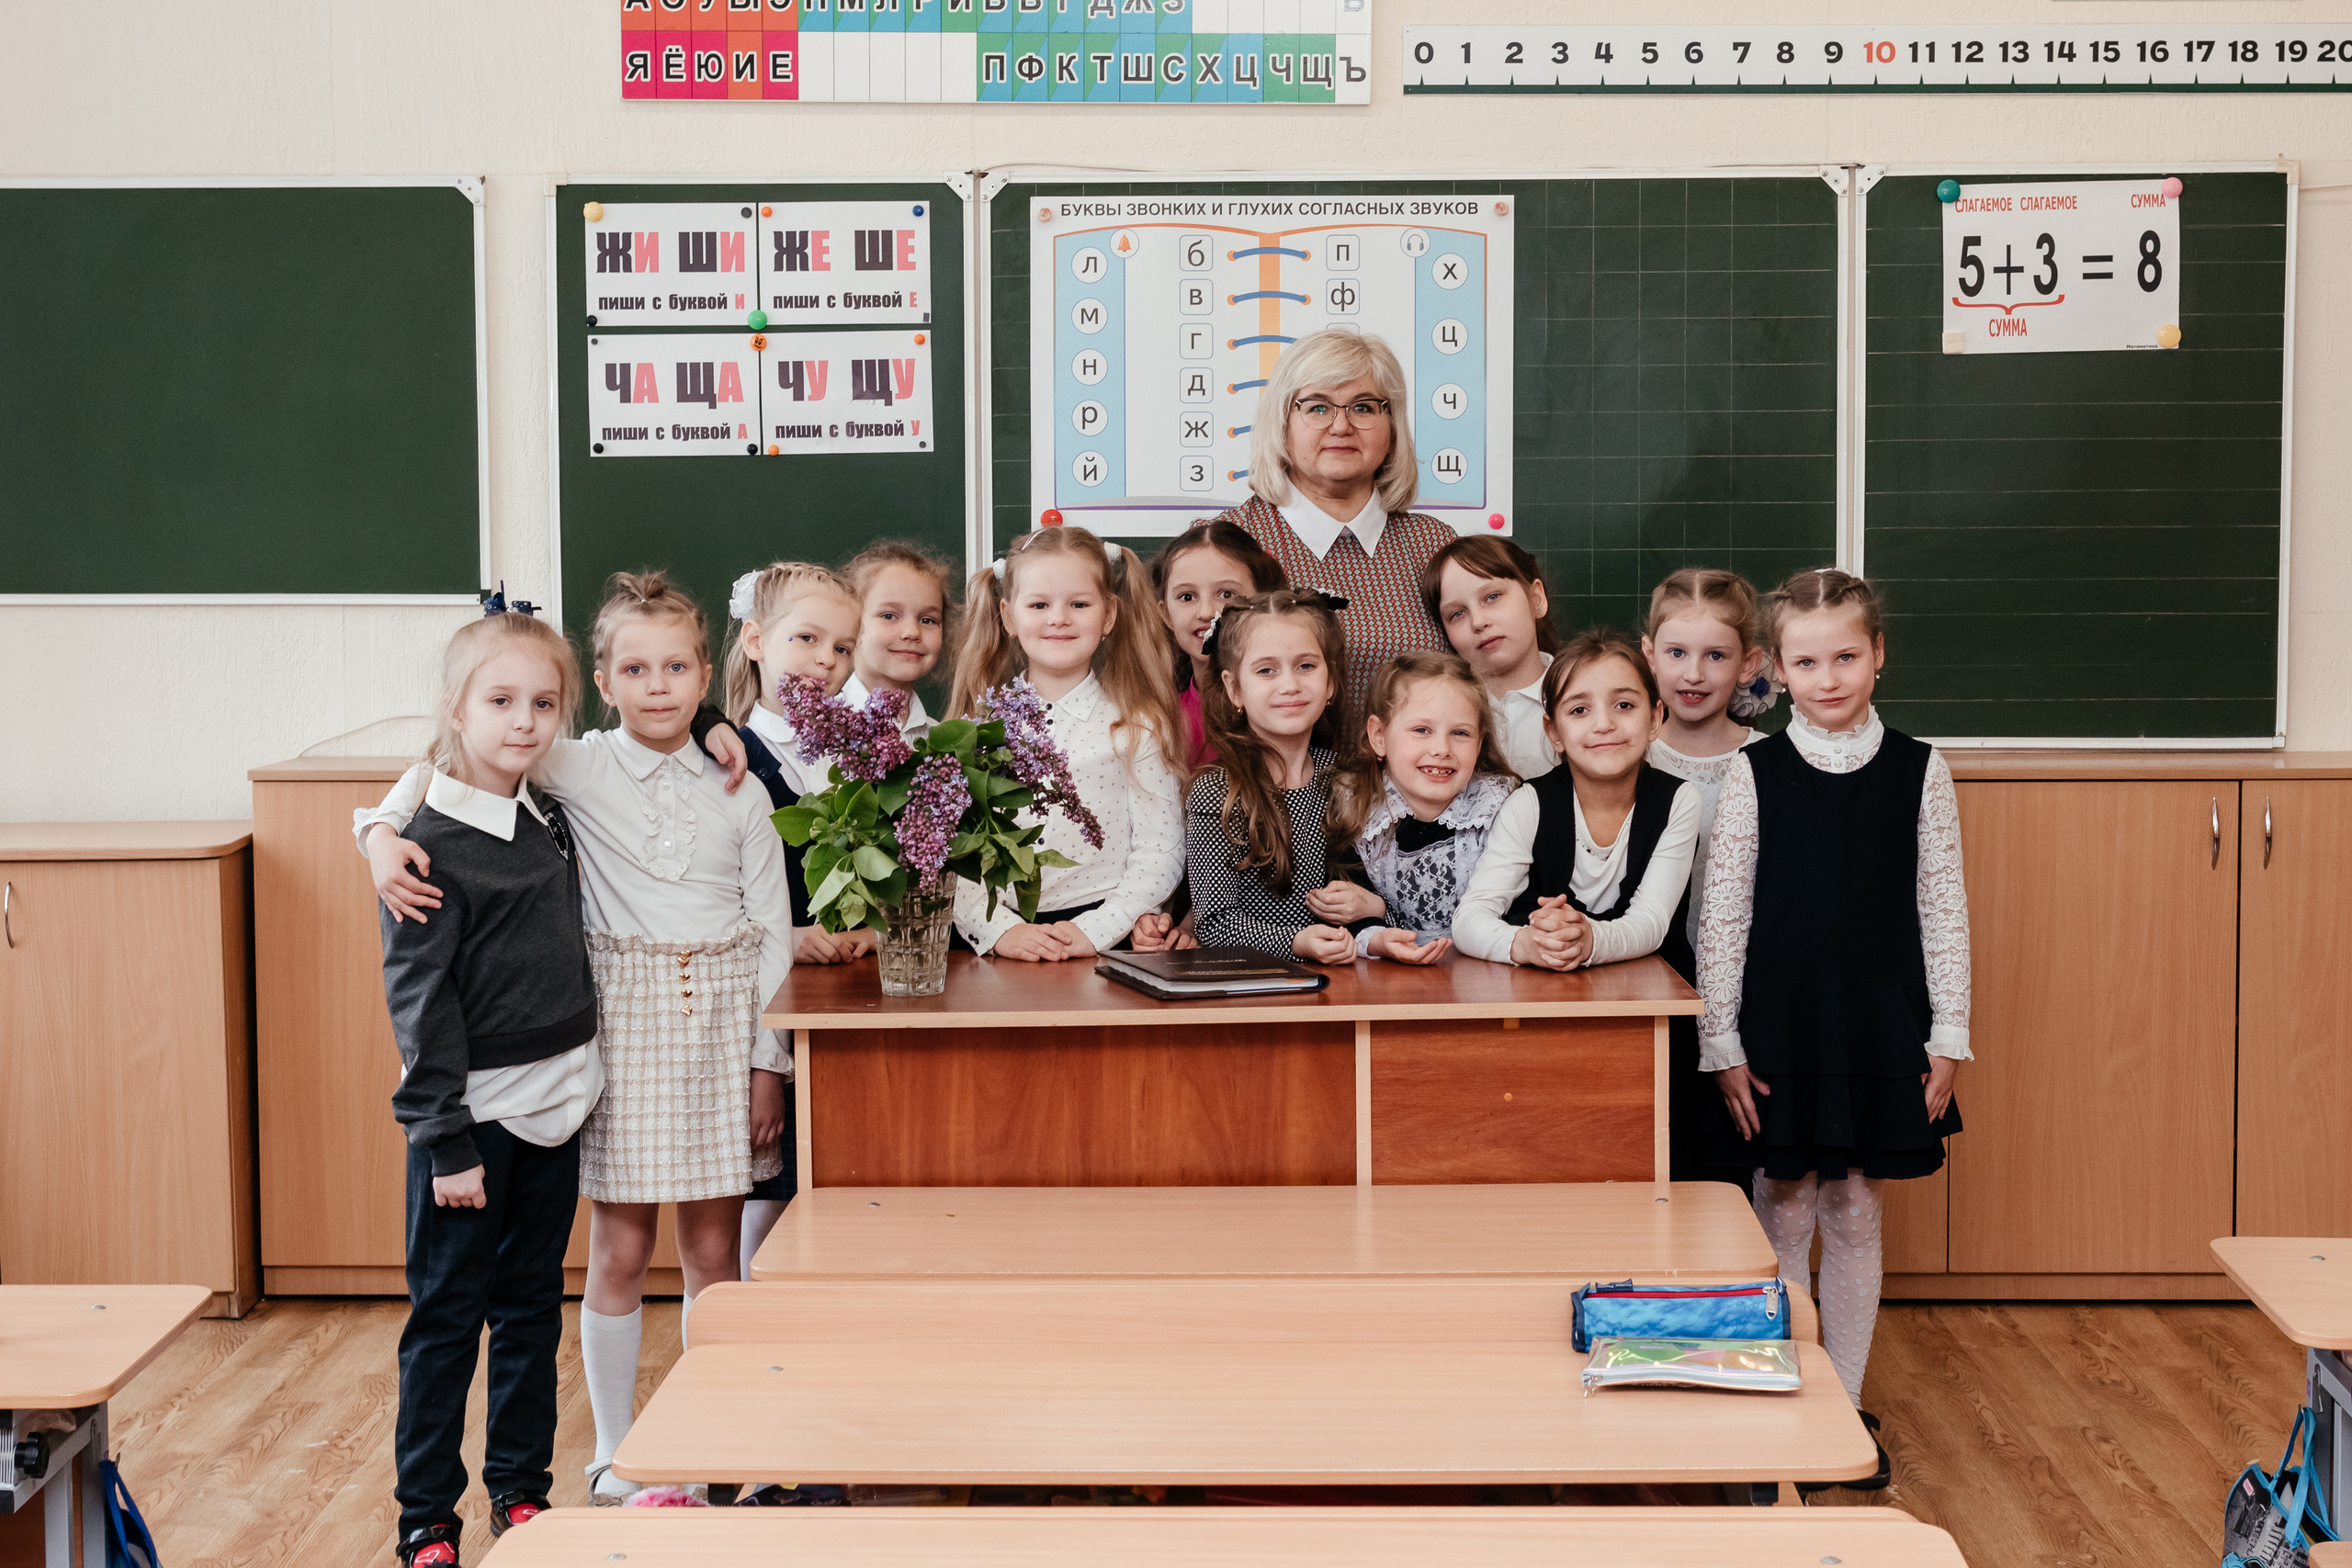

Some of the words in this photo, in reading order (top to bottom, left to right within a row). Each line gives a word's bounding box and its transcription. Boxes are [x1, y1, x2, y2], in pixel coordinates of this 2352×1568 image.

[1414, 41, 1434, 64] 0
[1461, 41, 1471, 64] 1
[1504, 41, 1523, 64] 2
[1551, 41, 1569, 64] 3
[1594, 41, 1614, 64] 4
[1641, 41, 1659, 64] 5
[1684, 41, 1704, 64] 6
[1732, 41, 1752, 63] 7
[1776, 41, 1795, 64] 8
[1824, 40, 1844, 64] 9
[1863, 40, 1896, 63] 10
[1908, 40, 1936, 63] 11
[1951, 40, 1984, 63] 12
[1998, 40, 2030, 63] 13
[2043, 40, 2077, 62] 14
[2089, 40, 2120, 63] 15
[2136, 39, 2169, 63] 16
[2183, 40, 2216, 62] 17
[2228, 39, 2259, 62] 18
[2275, 39, 2308, 62] 19
[2316, 39, 2352, 62] 20
[627, 53, 649, 79] Я
[665, 48, 684, 79] Ё
[696, 53, 723, 80] Ю
[735, 53, 755, 80] И
[772, 53, 791, 79] Е
[985, 54, 1005, 81] П
[1017, 55, 1044, 81] Ф
[1058, 55, 1077, 81] К
[1092, 55, 1112, 82] Т
[1123, 55, 1153, 82] Ш
[1163, 55, 1184, 82] С
[1199, 56, 1220, 82] Х
[1236, 56, 1257, 87] Ц
[1272, 56, 1291, 82] Ч
[1303, 56, 1332, 88] Щ
[1340, 56, 1366, 82] Ъ
[1061, 203, 1121, 217] БУКВЫ
[1126, 202, 1206, 216] ЗВОНКИХ
[1212, 202, 1223, 216] И
[1228, 202, 1294, 216] ГЛУХИХ
[1298, 202, 1405, 216] СОГЛАСНЫХ
[1409, 201, 1478, 215] ЗВУКОВ
[1954, 196, 2013, 213] СЛАГАЕМОЕ
[2019, 195, 2078, 211] СЛАГАЕМОЕ
[2131, 193, 2166, 209] СУММА
[595, 231, 660, 274] ЖИ
[678, 231, 745, 273] ШИ
[773, 230, 831, 272] ЖЕ
[854, 230, 916, 271] ШЕ
[1187, 239, 1205, 267] б
[1336, 244, 1350, 262] п
[1081, 256, 1098, 274] л
[1442, 263, 1458, 280] х
[2137, 230, 2163, 293] 8
[598, 297, 645, 310] пиши
[652, 296, 662, 310] с
[668, 292, 728, 311] буквой
[734, 293, 745, 310] И
[773, 295, 820, 310] пиши
[826, 295, 836, 309] с
[842, 290, 902, 310] буквой
[909, 291, 918, 308] Е
[1189, 288, 1204, 306] в
[1330, 281, 1356, 312] ф
[1080, 308, 1099, 325] м
[1442, 325, 1458, 347] ц
[1988, 318, 2028, 338] СУММА
[1191, 333, 1203, 350] г
[1082, 358, 1097, 376] н
[605, 362, 660, 404] ЧА
[675, 361, 744, 410] ЩА
[777, 360, 829, 402] ЧУ
[851, 358, 915, 407] ЩУ
[1187, 374, 1206, 397] д
[1442, 392, 1457, 410] ч
[1081, 406, 1098, 430] р
[602, 426, 649, 441] пиши
[655, 426, 665, 441] с
[672, 422, 731, 442] буквой
[737, 423, 749, 440] А
[775, 424, 822, 439] пиши
[829, 423, 839, 438] с
[845, 419, 905, 439] буквой
[910, 420, 921, 436] У
[1184, 421, 1209, 438] ж
[1082, 456, 1099, 482] й
[1189, 464, 1204, 482] з
[1436, 457, 1463, 478] щ
